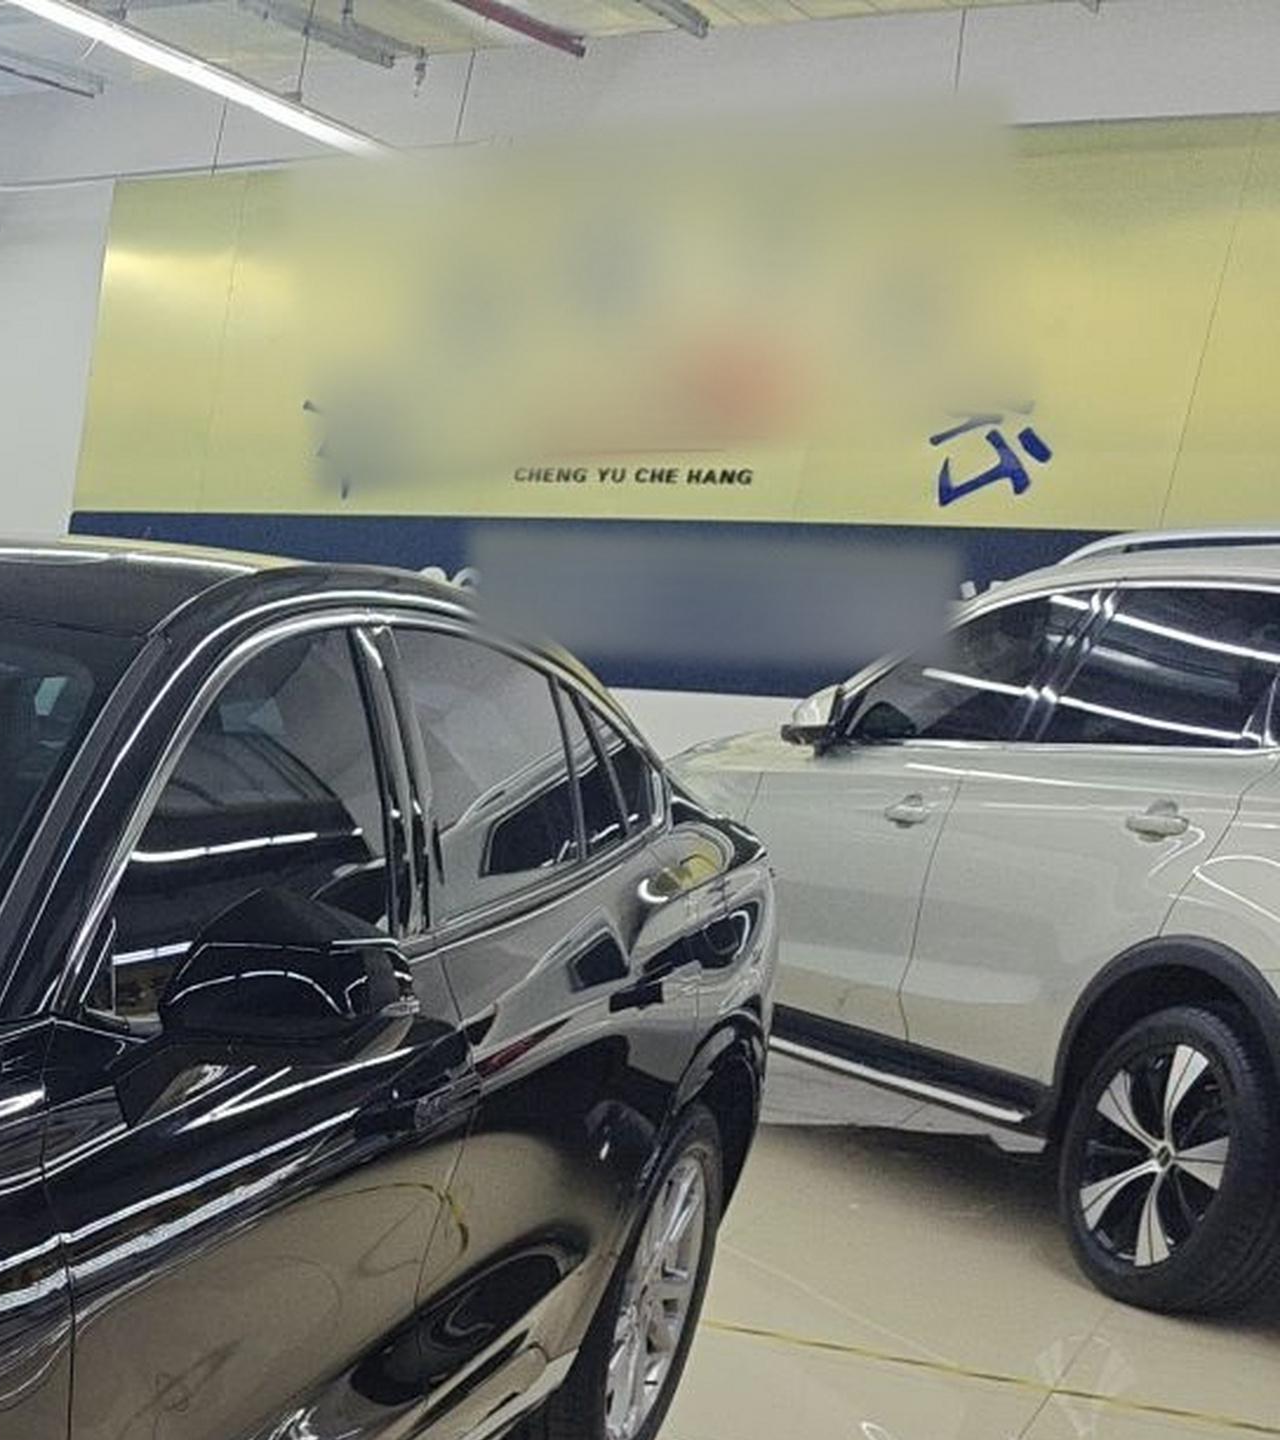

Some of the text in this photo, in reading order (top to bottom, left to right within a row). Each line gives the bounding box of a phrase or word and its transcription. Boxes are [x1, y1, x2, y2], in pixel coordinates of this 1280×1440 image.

[513, 467, 754, 486] CHENG YU CHE HANG
